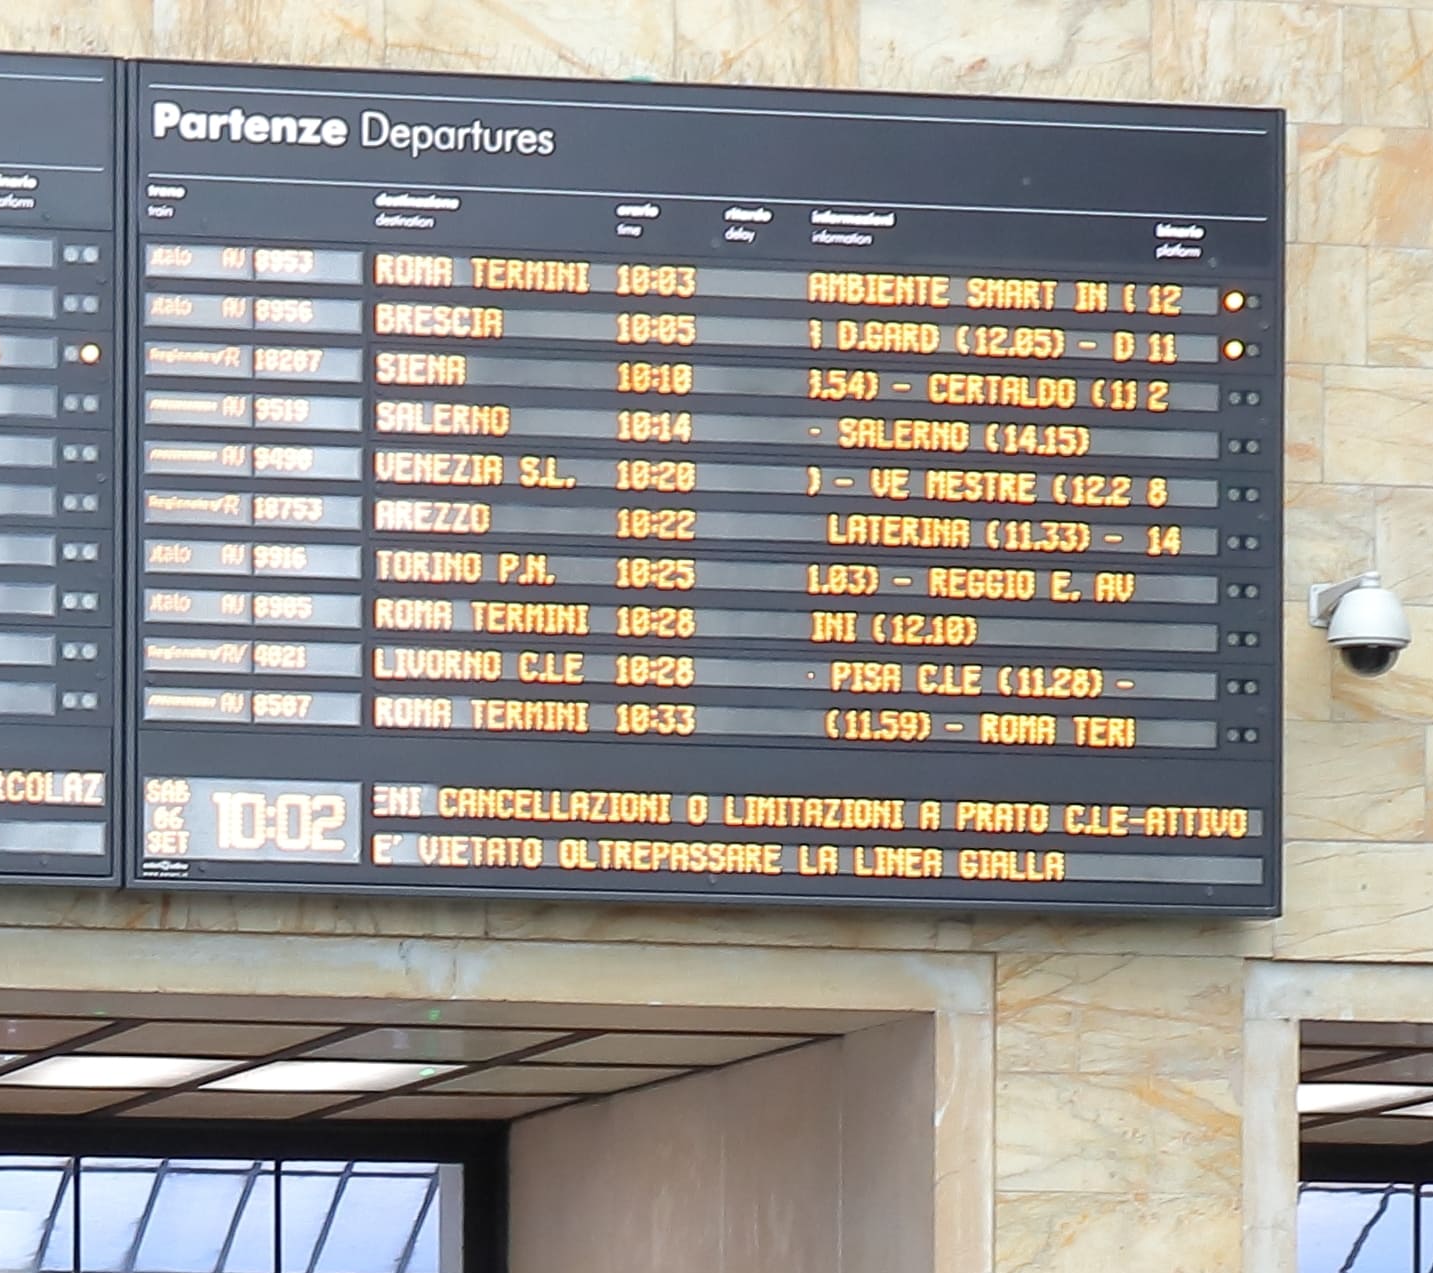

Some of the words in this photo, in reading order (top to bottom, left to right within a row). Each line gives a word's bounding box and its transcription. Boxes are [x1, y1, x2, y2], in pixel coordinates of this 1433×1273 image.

[152, 101, 348, 146] Partenze
[360, 111, 555, 157] Departures
[375, 255, 453, 287] ROMA
[470, 258, 590, 293] TERMINI
[616, 264, 697, 297] 10:03
[808, 272, 950, 308] AMBIENTE
[967, 278, 1057, 311] SMART
[1075, 282, 1107, 314] IN
[1147, 284, 1182, 316] 12
[375, 304, 503, 338] BRESCIA
[616, 314, 697, 345] 10:05
[375, 354, 466, 386] SIENA
[616, 362, 693, 395] 10:10
[928, 372, 1077, 408] CERTALDO
[375, 402, 510, 436] SALERNO
[616, 411, 692, 443] 10:14
[838, 418, 969, 452] SALERNO
[374, 453, 503, 486] VENEZIA
[616, 461, 696, 492] 10:20
[870, 468, 909, 499] VE
[926, 470, 1036, 505] MESTRE
[375, 500, 491, 534] AREZZO
[616, 509, 696, 540] 10:22
[828, 514, 971, 549] LATERINA
[1147, 525, 1181, 556] 14
[376, 550, 482, 584] TORINO
[616, 558, 696, 589] 10:25
[928, 567, 1034, 600] REGGIO
[375, 599, 452, 631] ROMA
[471, 602, 590, 636] TERMINI
[616, 607, 696, 638] 10:28
[373, 648, 502, 682] LIVORNO
[615, 656, 696, 687] 10:28
[830, 662, 902, 694] PISA
[374, 697, 452, 729] ROMA
[470, 700, 590, 733] TERMINI
[615, 704, 696, 736] 10:33
[980, 713, 1057, 746] ROMA
[212, 791, 346, 851] 10:02
[438, 787, 672, 824] CANCELLAZIONI
[724, 795, 905, 830] LIMITAZIONI
[956, 802, 1049, 833] PRATO
[418, 834, 544, 868] VIETATO
[558, 837, 782, 874] OLTREPASSARE
[799, 844, 838, 876] LA
[853, 846, 943, 878] LINEA
[958, 850, 1066, 881] GIALLA
